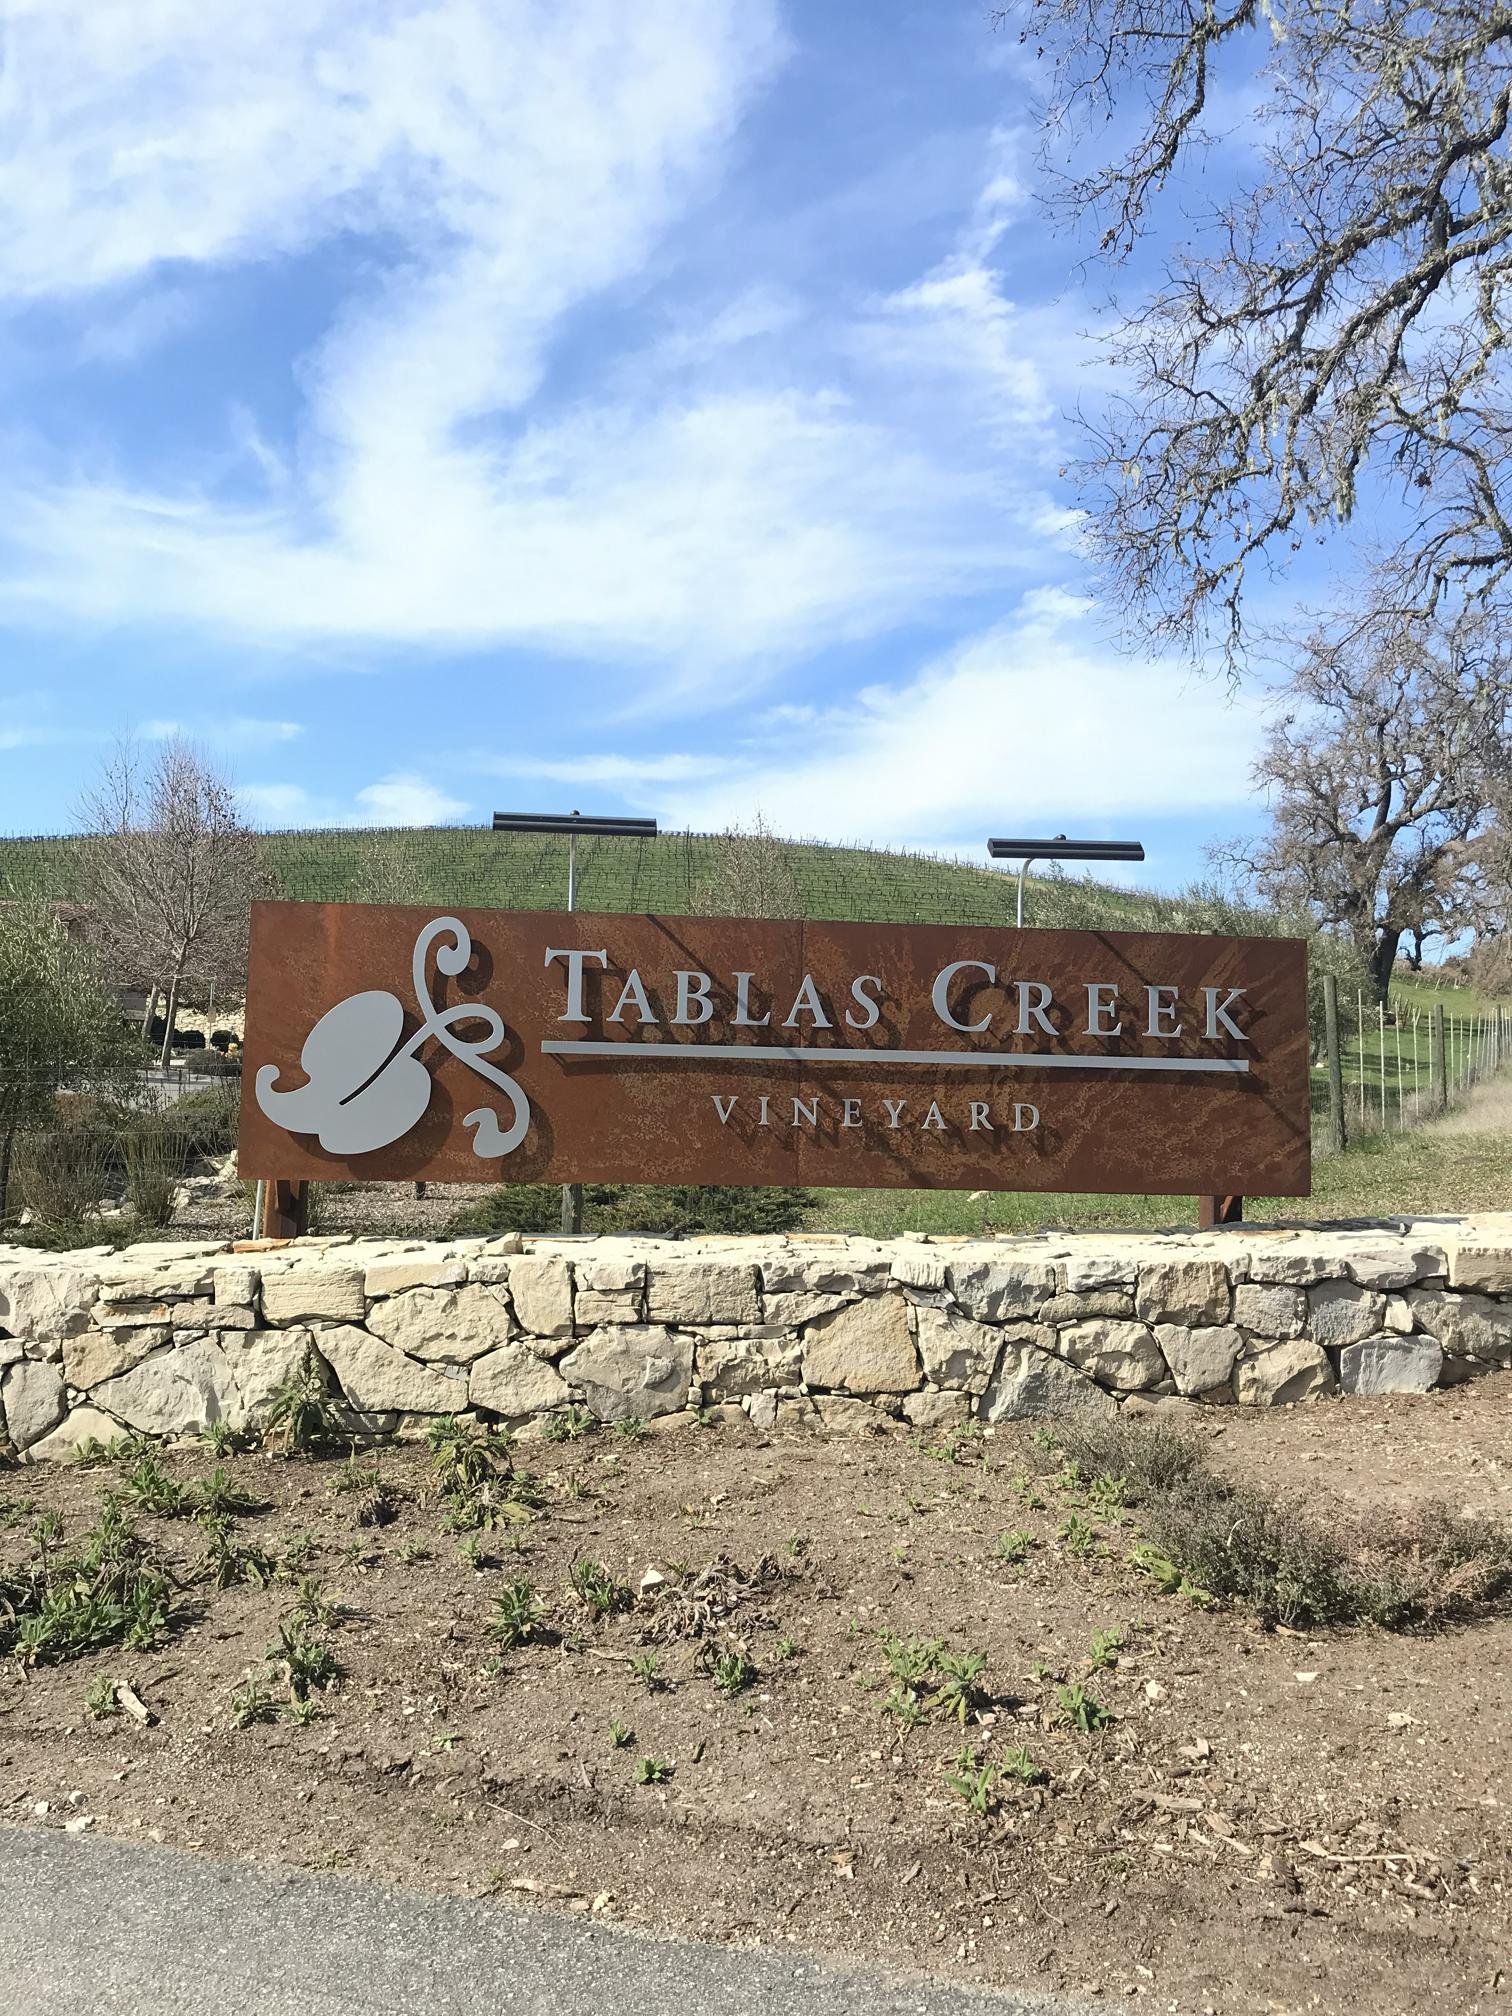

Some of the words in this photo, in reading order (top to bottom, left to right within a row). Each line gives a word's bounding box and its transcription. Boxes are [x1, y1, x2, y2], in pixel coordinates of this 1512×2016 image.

[544, 946, 882, 1029] TABLAS
[931, 960, 1249, 1040] CREEK
[711, 1095, 1041, 1132] VINEYARD
